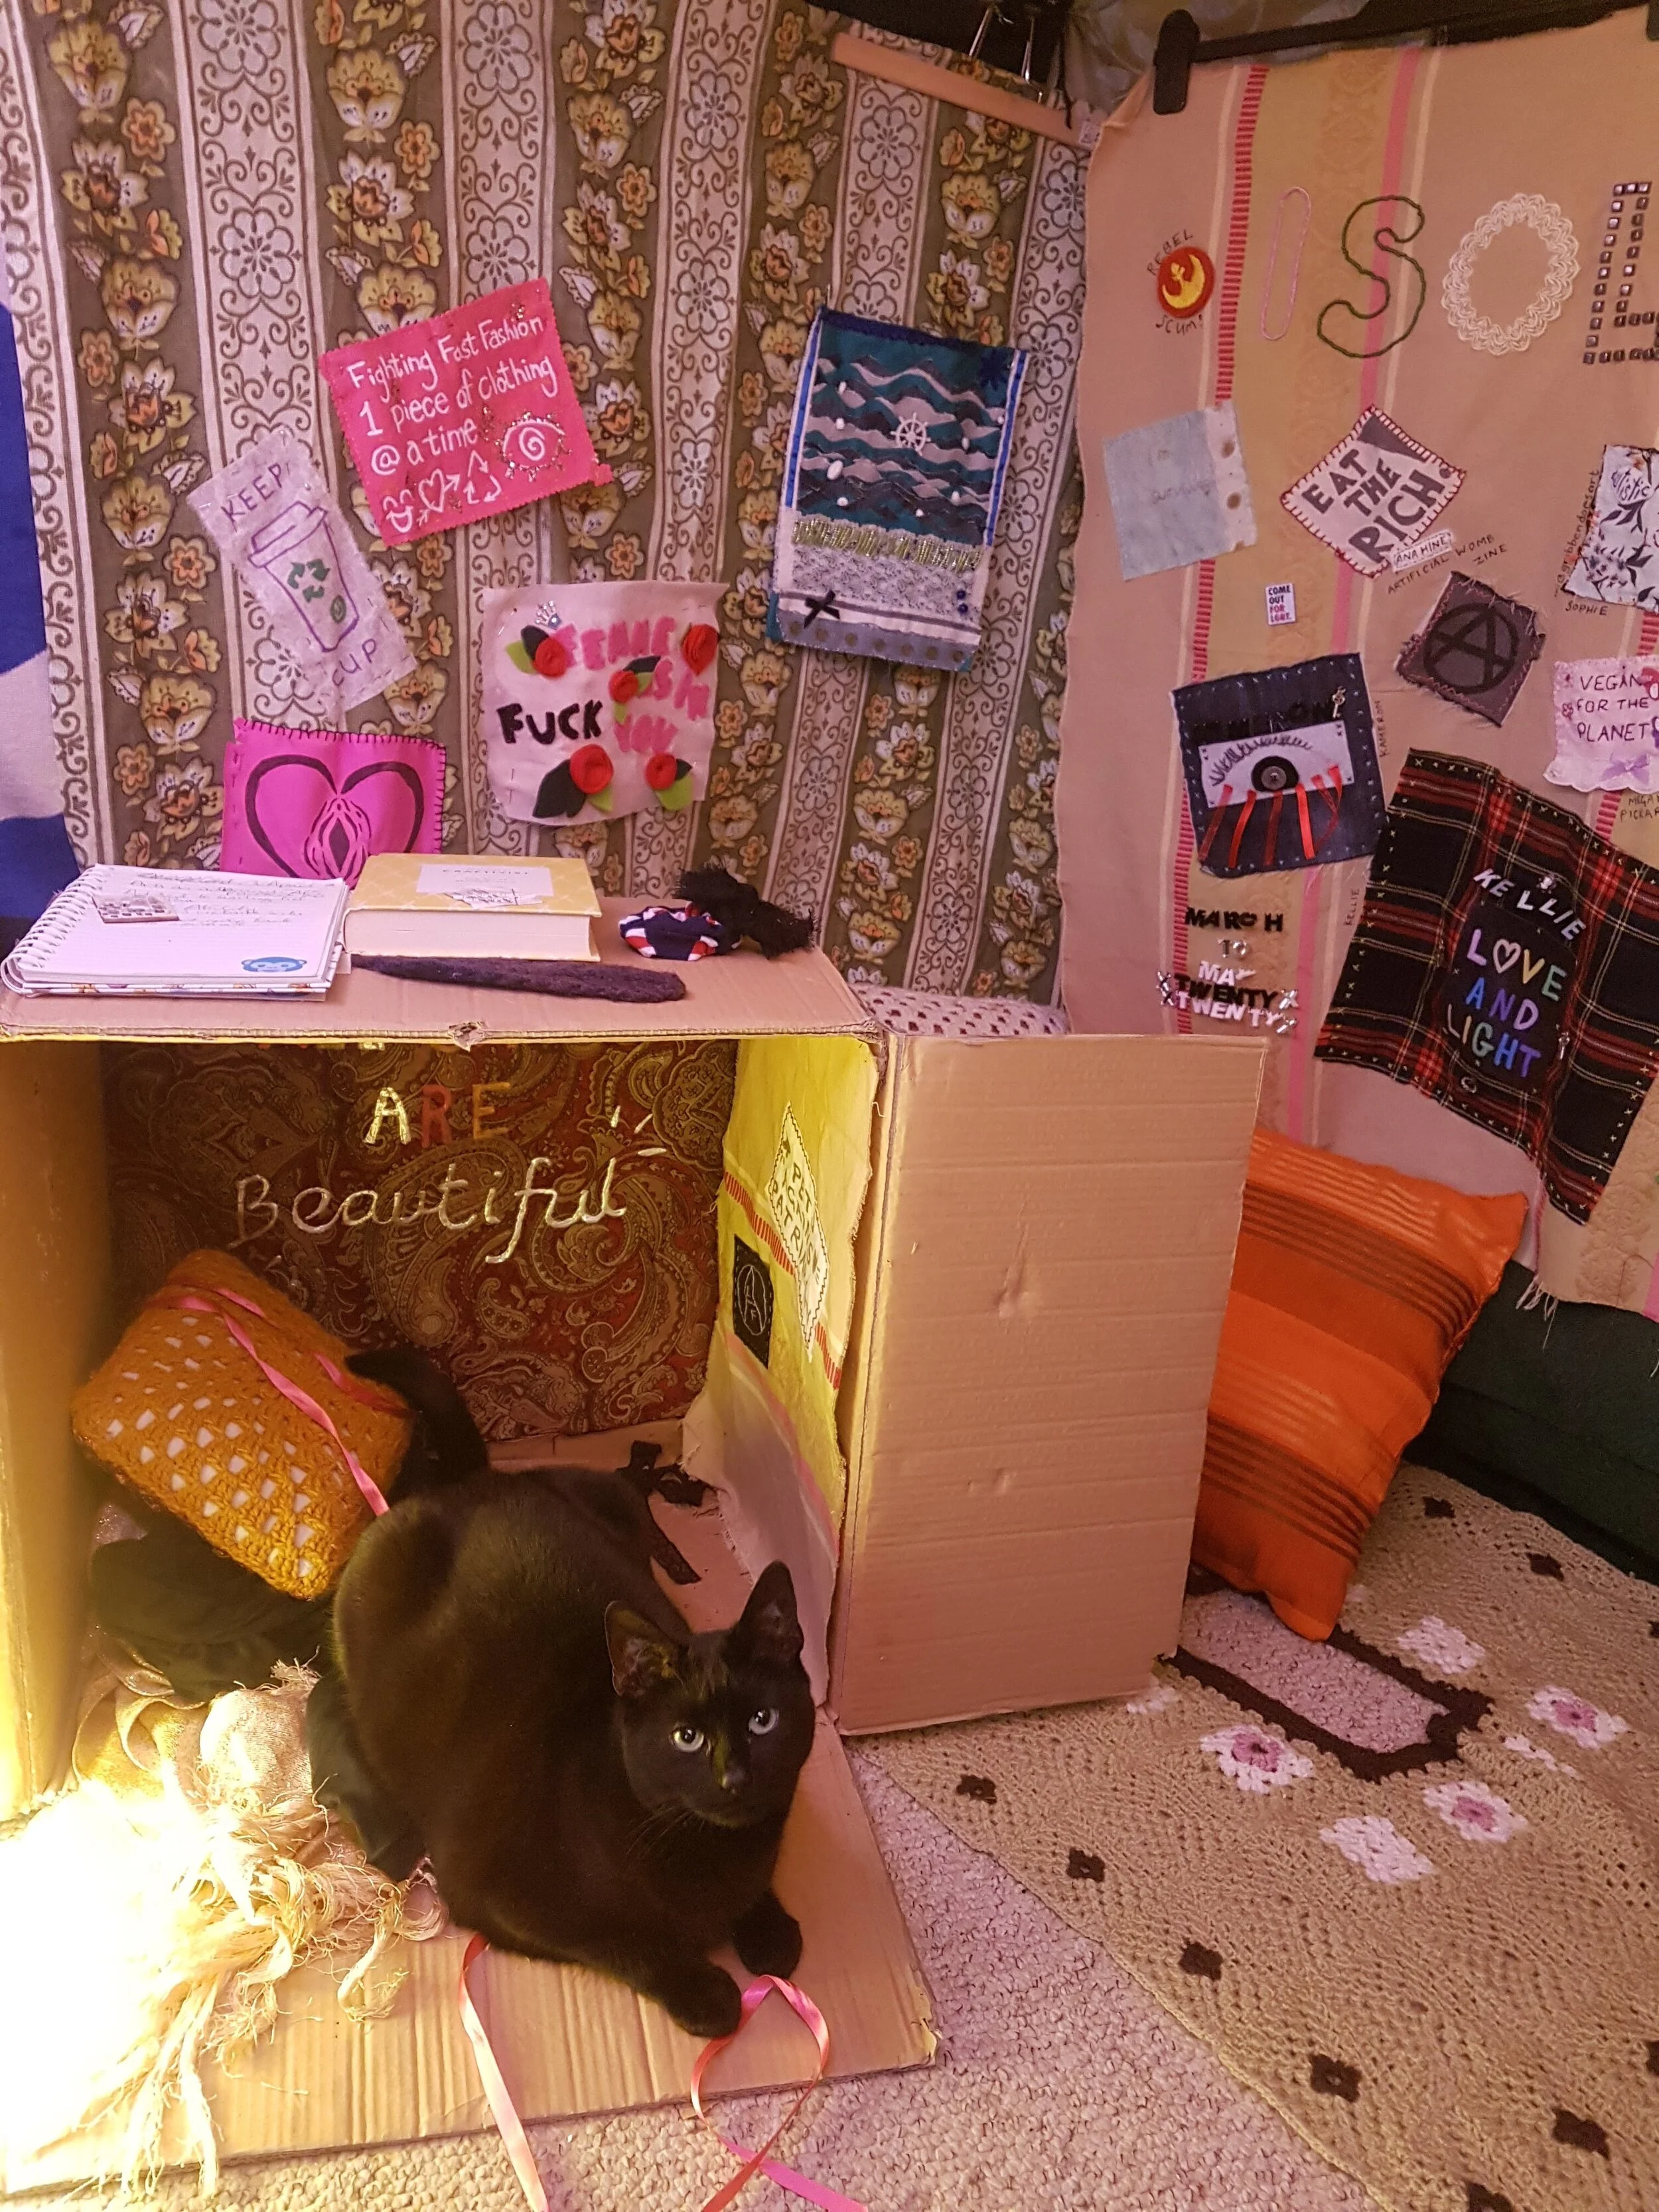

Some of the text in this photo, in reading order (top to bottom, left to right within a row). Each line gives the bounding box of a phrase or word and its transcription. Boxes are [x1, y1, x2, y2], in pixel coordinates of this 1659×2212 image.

[1147, 229, 1192, 275] REBEL
[346, 316, 543, 403] Fighting Fast Fashion
[358, 355, 559, 437] 1 piece of clothing
[370, 417, 478, 475] @ a time
[221, 463, 283, 533] KEEP
[1301, 449, 1368, 514] EAT
[1344, 458, 1401, 516] THE
[1388, 534, 1507, 594] ARTIFICIAL WOMB ZINE
[1396, 537, 1449, 565] ANA HINE
[1268, 585, 1291, 596] COME
[1269, 595, 1284, 605] OUT
[1565, 600, 1609, 616] SOPHIE
[332, 637, 378, 688] CUP
[1580, 673, 1643, 692] VEGAN
[496, 700, 603, 745] FUCK
[1577, 697, 1649, 713] FOR THE
[1577, 721, 1650, 743] PLANET
[1628, 794, 1659, 808] MEGA
[1185, 907, 1284, 932] MARCH
[1473, 868, 1586, 940] KELLIE
[1218, 938, 1248, 960] TO
[1174, 973, 1279, 1008] TWENTY
[1198, 960, 1256, 987] MAY
[1175, 990, 1283, 1027] TWENTY
[1465, 977, 1540, 1031] AND
[1443, 1003, 1542, 1078] LIGHT
[363, 1082, 510, 1149] ARE
[230, 1156, 626, 1264] Beautiful
